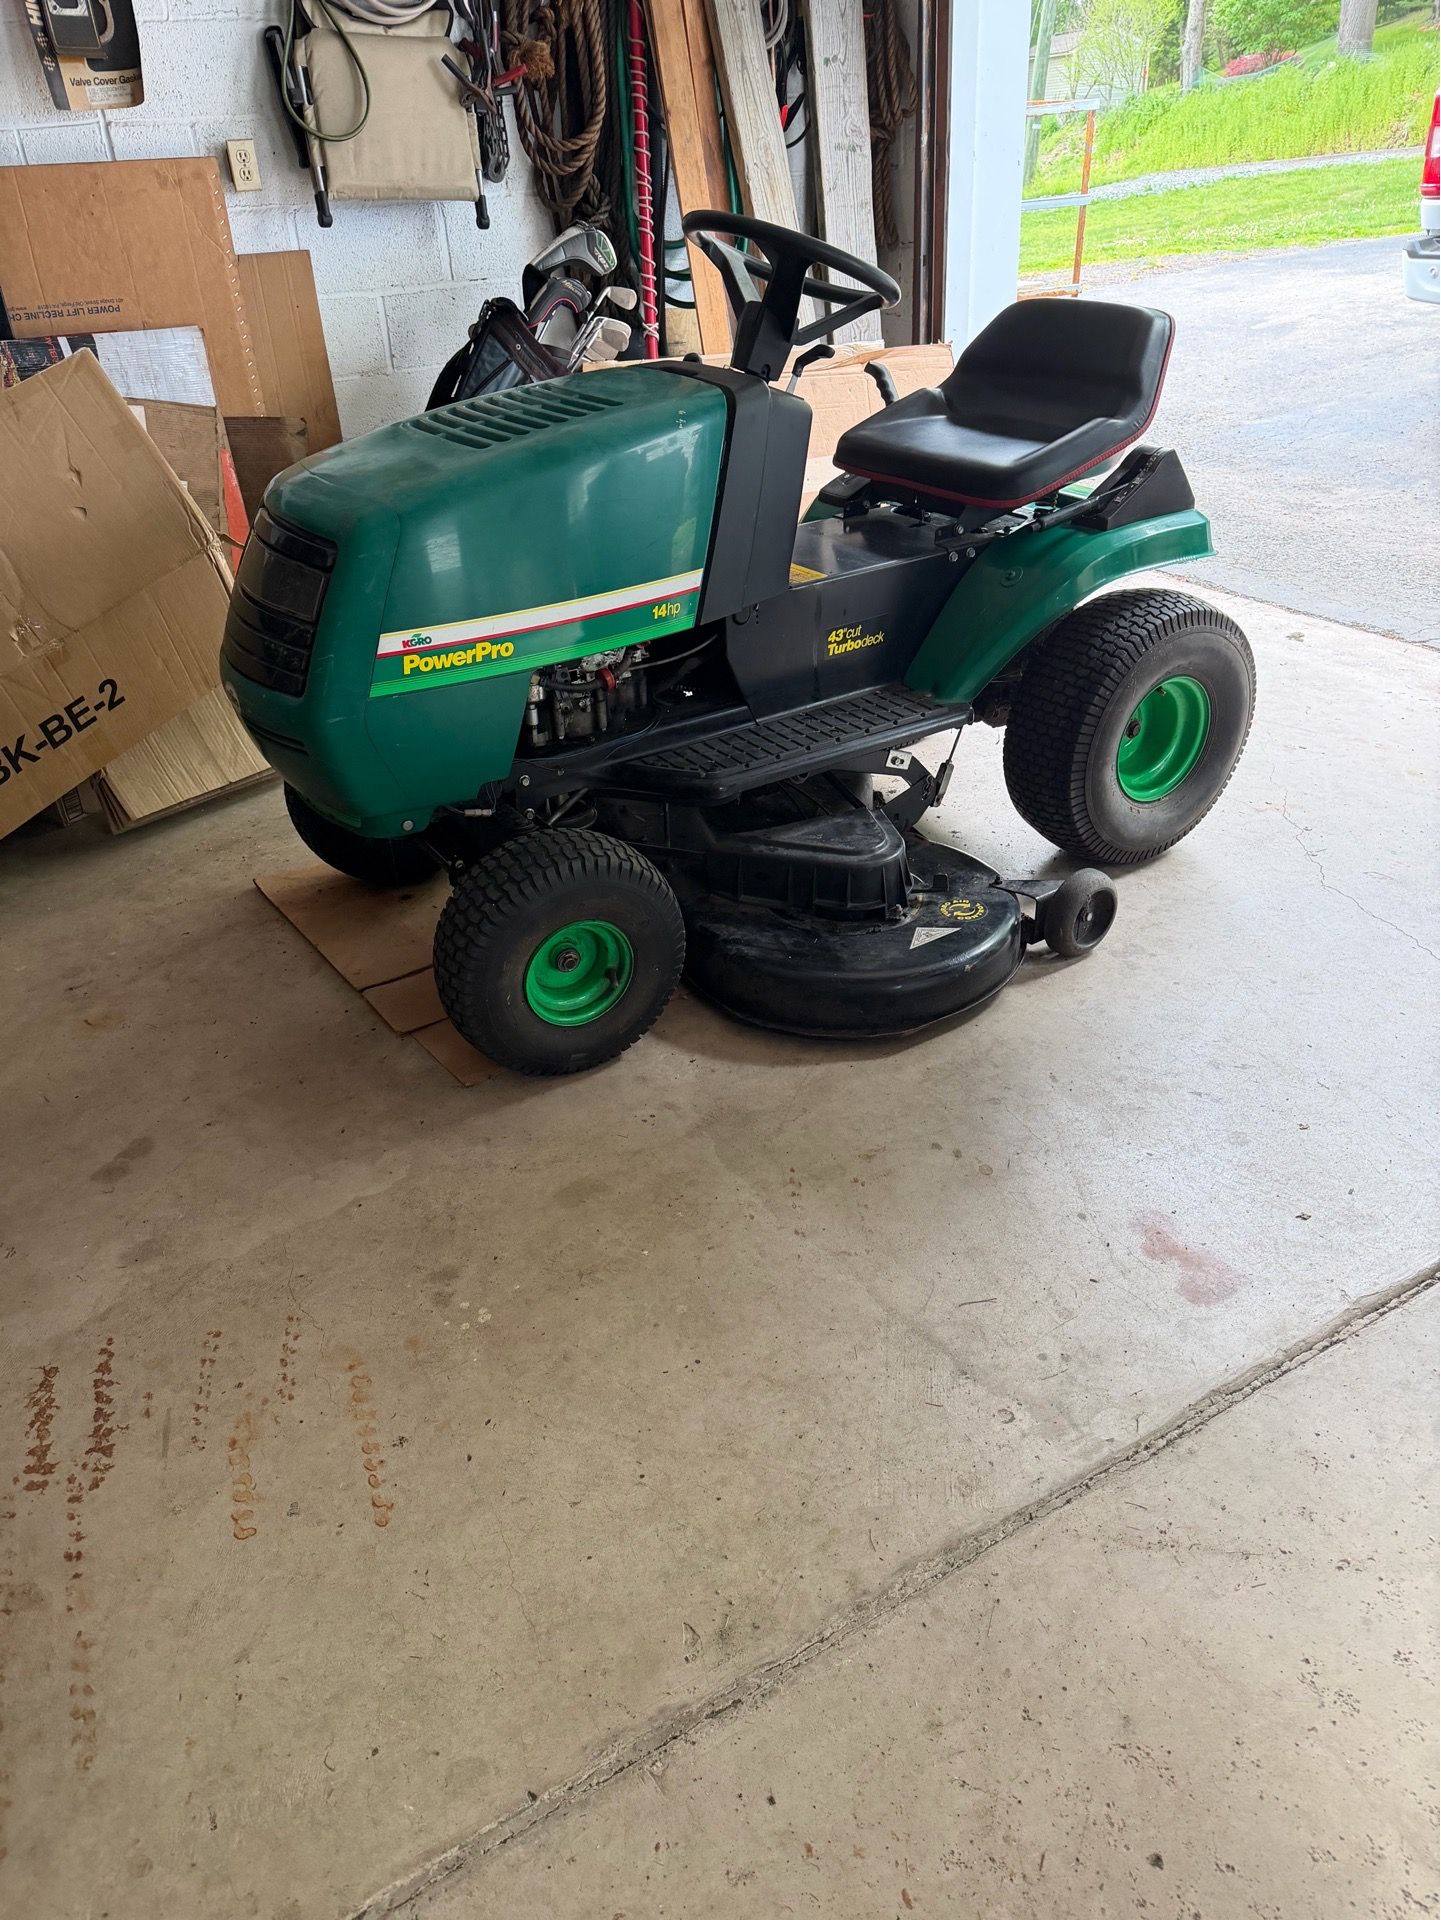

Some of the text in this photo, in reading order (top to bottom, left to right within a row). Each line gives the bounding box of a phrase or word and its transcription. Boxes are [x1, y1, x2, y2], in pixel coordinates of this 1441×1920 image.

[69, 77, 92, 87] Valve
[93, 76, 118, 86] Cover
[24, 309, 64, 321] RECLINE
[66, 307, 85, 317] LIFT
[87, 304, 121, 315] POWER
[402, 635, 432, 648] KGRO
[403, 641, 514, 675] PowerPro
